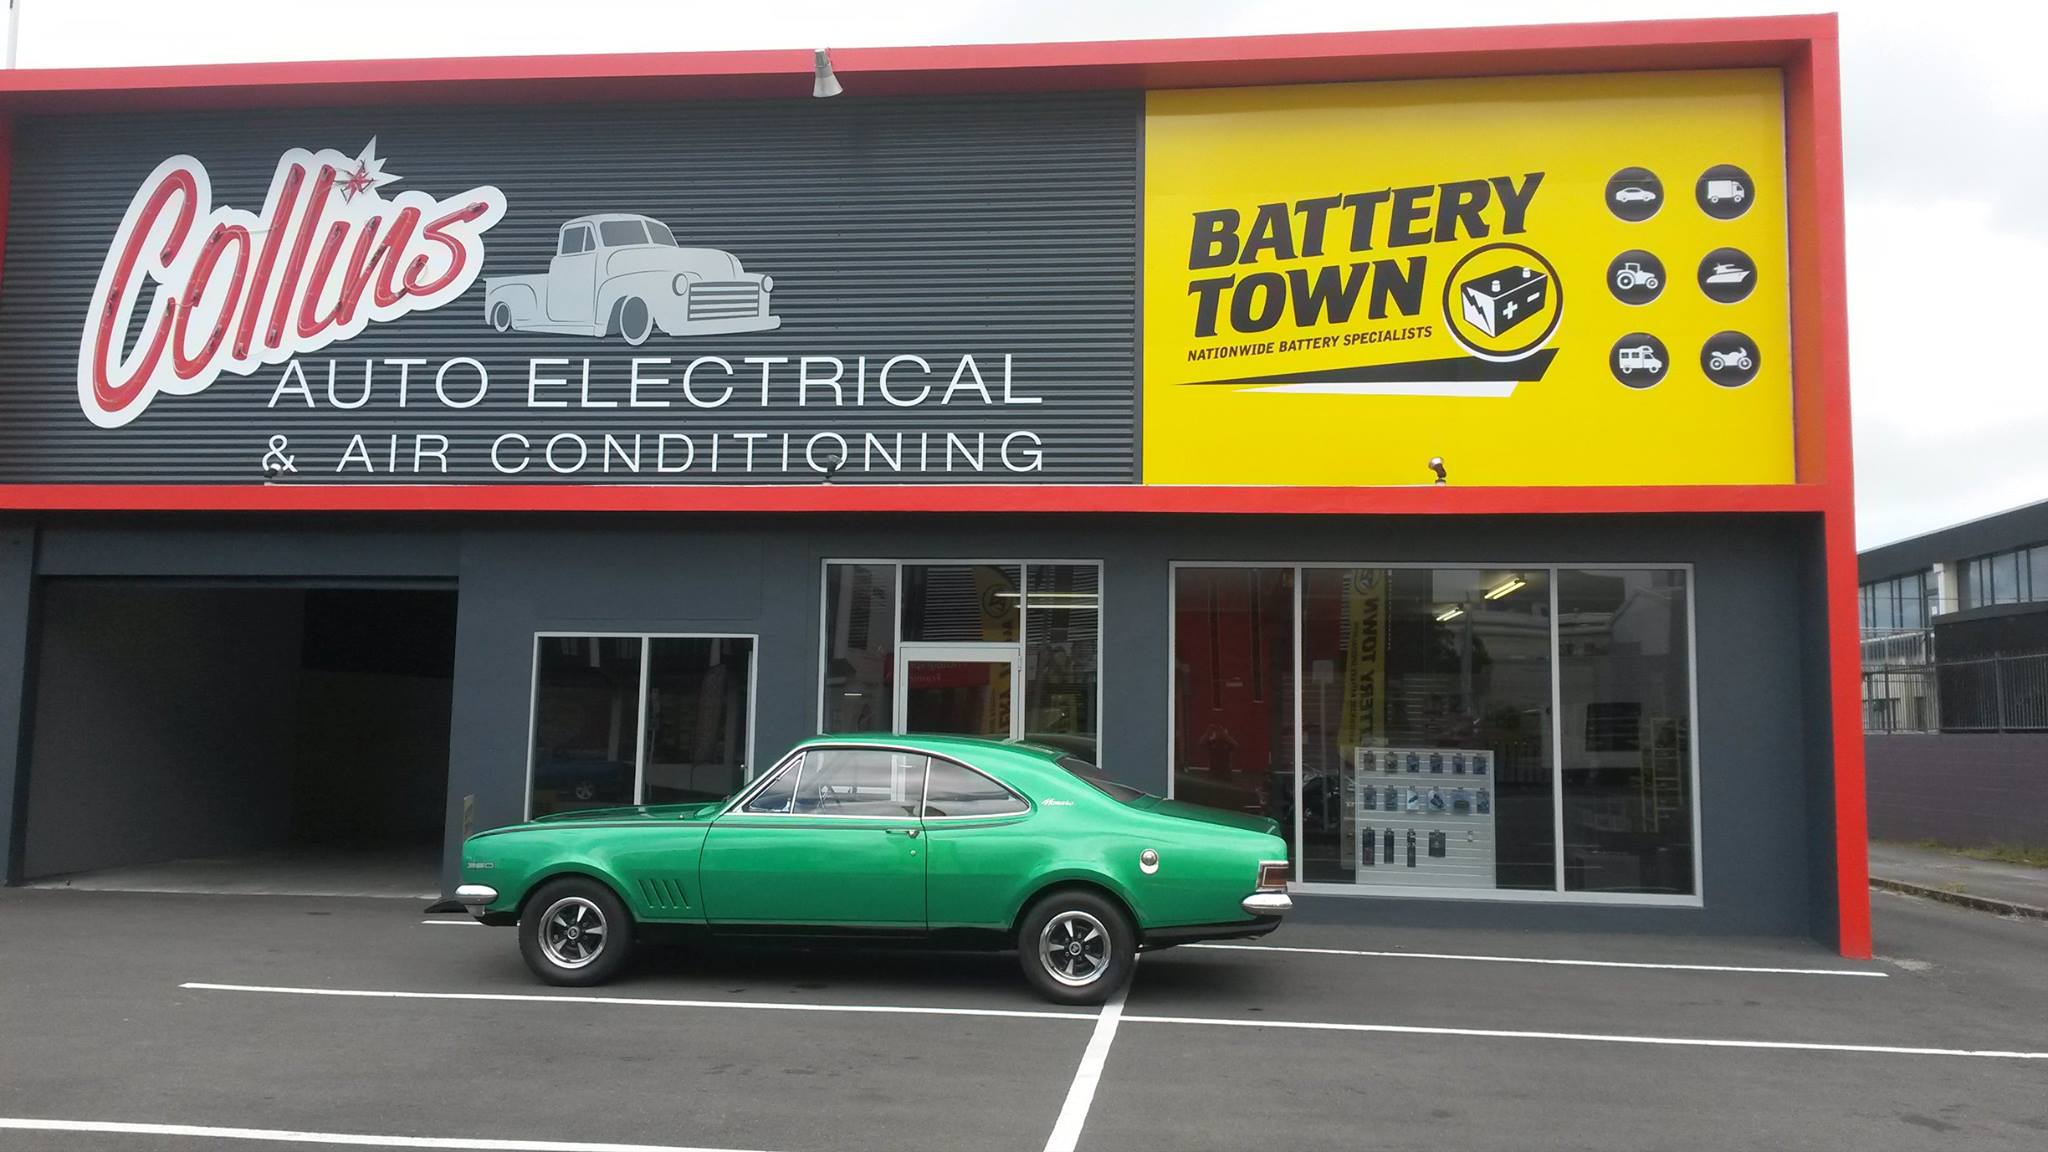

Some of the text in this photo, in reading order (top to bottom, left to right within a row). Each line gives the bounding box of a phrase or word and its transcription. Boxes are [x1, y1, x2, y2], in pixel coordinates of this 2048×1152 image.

[1187, 171, 1546, 270] BATTERY
[88, 158, 497, 418] Collins
[1187, 255, 1428, 338] TOWN
[1187, 325, 1433, 362] NATIONWIDE BATTERY SPECIALISTS
[267, 353, 1043, 409] AUTO ELECTRICAL
[261, 430, 1043, 475] & AIR CONDITIONING
